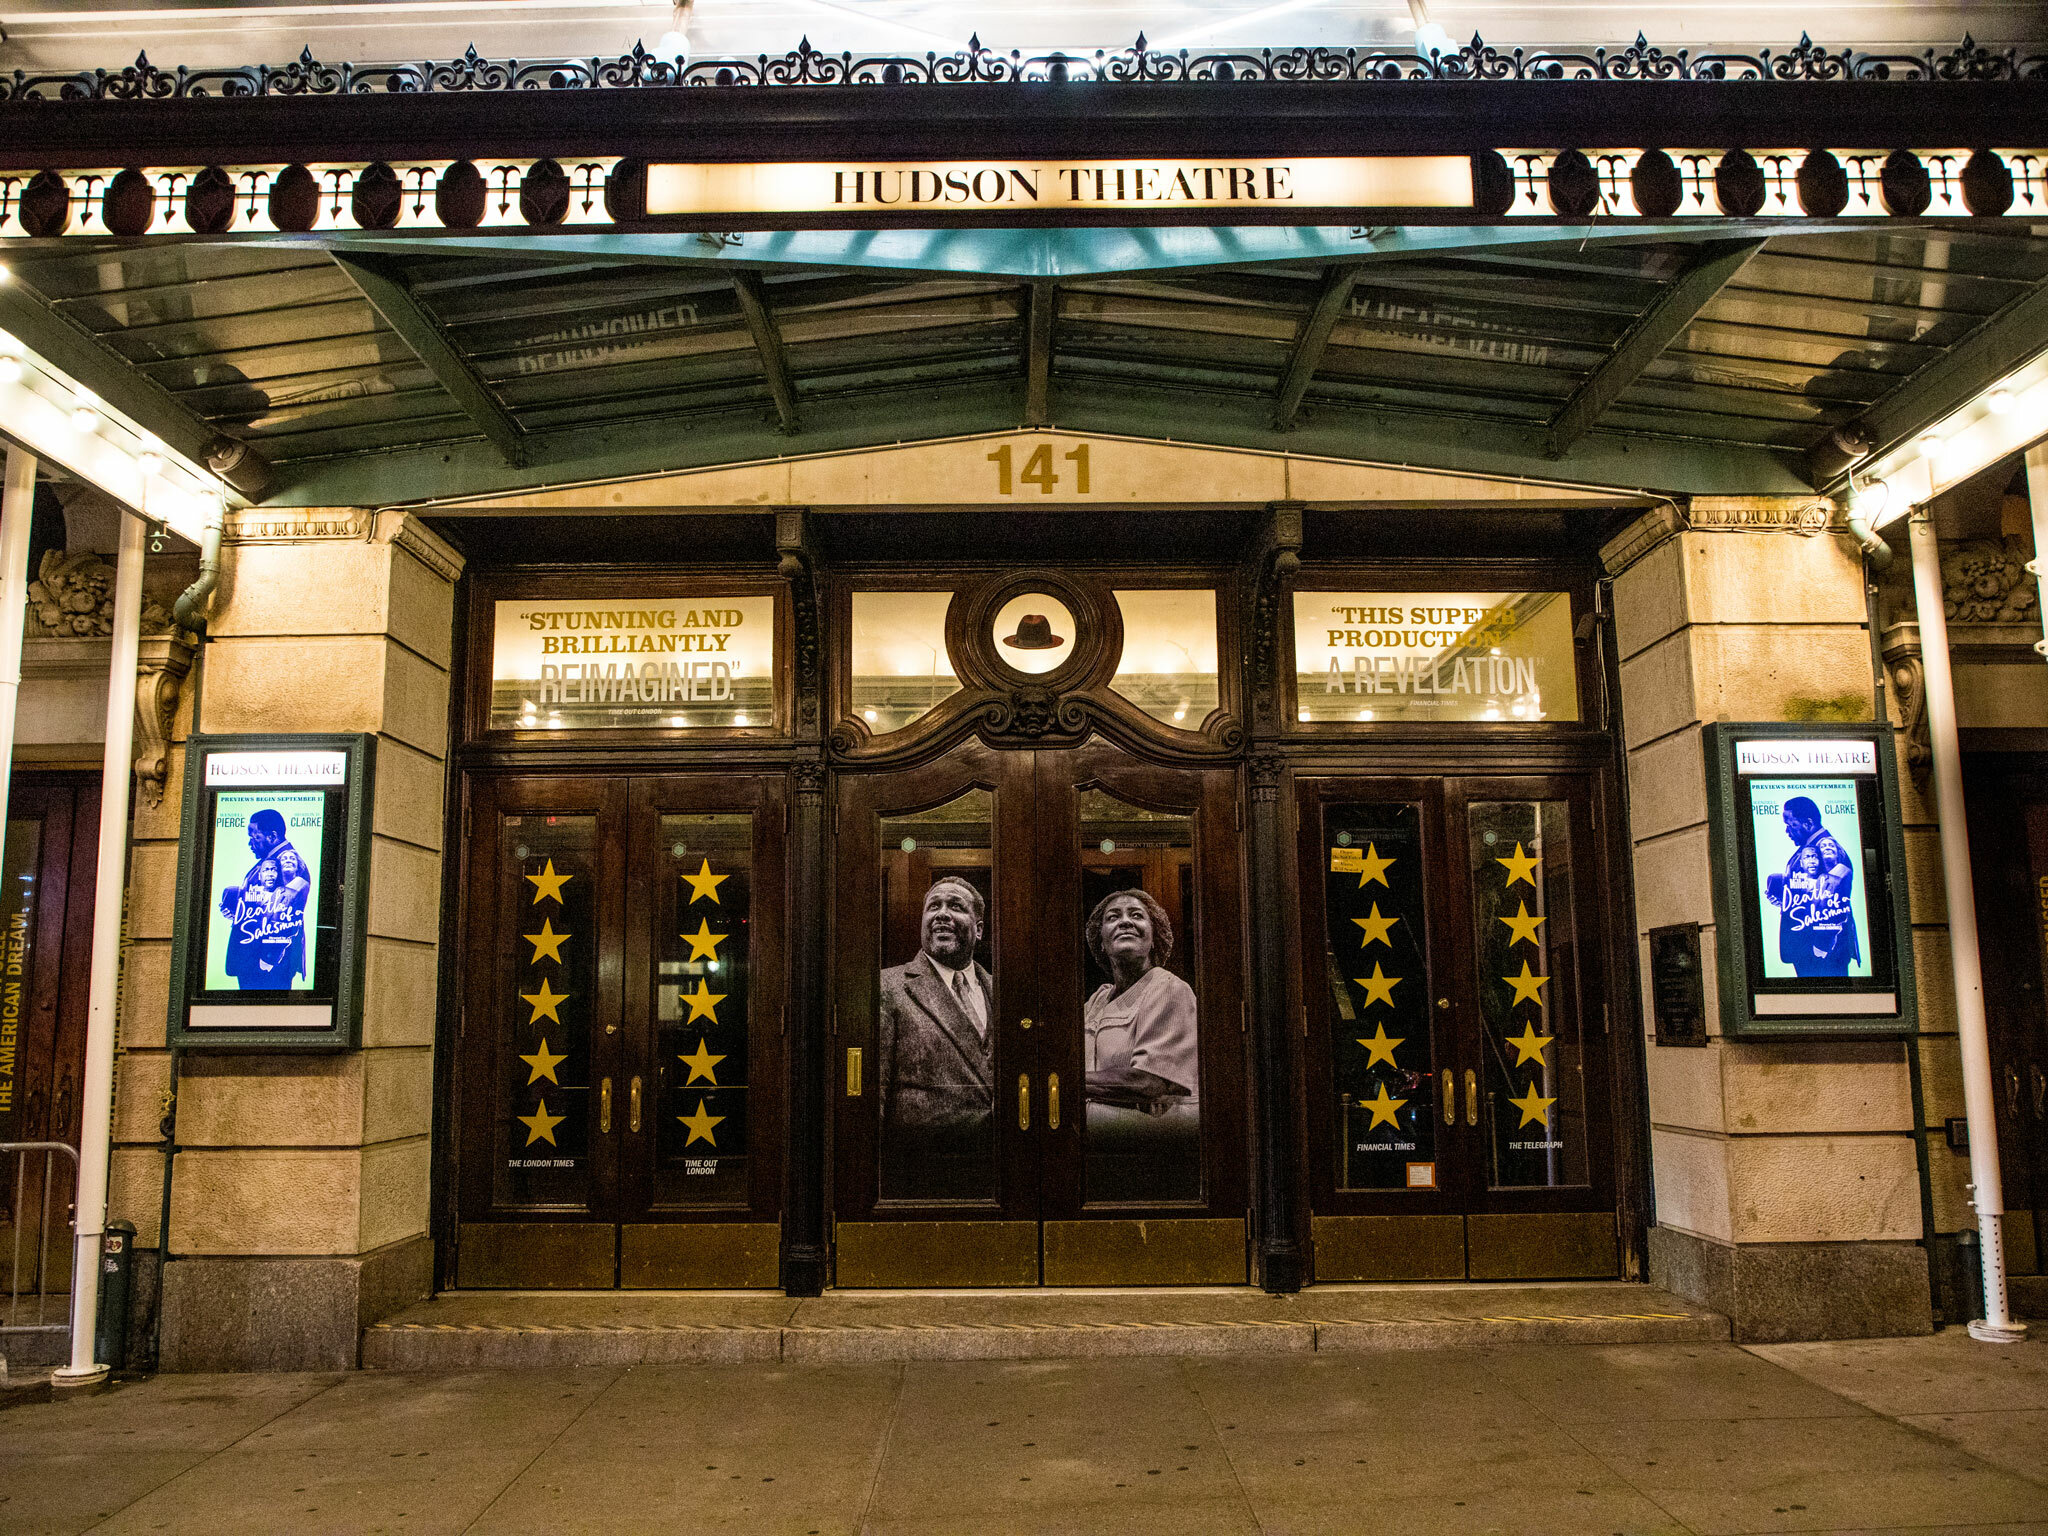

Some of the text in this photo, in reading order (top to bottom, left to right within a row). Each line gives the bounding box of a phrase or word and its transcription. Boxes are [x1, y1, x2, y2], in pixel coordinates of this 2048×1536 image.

[831, 166, 1294, 204] HUDSON THEATRE
[987, 444, 1090, 495] 141
[520, 609, 744, 631] “STUNNING AND
[1331, 606, 1517, 625] “THIS SUPERB
[541, 633, 732, 655] BRILLIANTLY
[1325, 655, 1545, 696] A REVELATION”
[1742, 751, 1871, 764] HUDSON THEATRE
[210, 763, 342, 776] HUDSON THEATRE
[1752, 805, 1780, 815] PIERCE
[1824, 804, 1856, 815] CLARKE
[216, 817, 246, 828] PIERCE
[290, 816, 322, 828] CLARKE
[1783, 876, 1834, 912] Death
[1827, 893, 1840, 908] of
[234, 888, 288, 925] Death
[280, 906, 294, 921] of
[1789, 903, 1851, 931] Salesman
[240, 916, 303, 944] Salesman
[0, 913, 27, 1113] THE AMERICAN DREAM
[1356, 1142, 1416, 1151] FINANCIAL TIMES
[1509, 1141, 1563, 1149] THE TELEGRAPH
[508, 1159, 575, 1167] THE LONDON TIMES
[685, 1159, 718, 1167] TIME OUT
